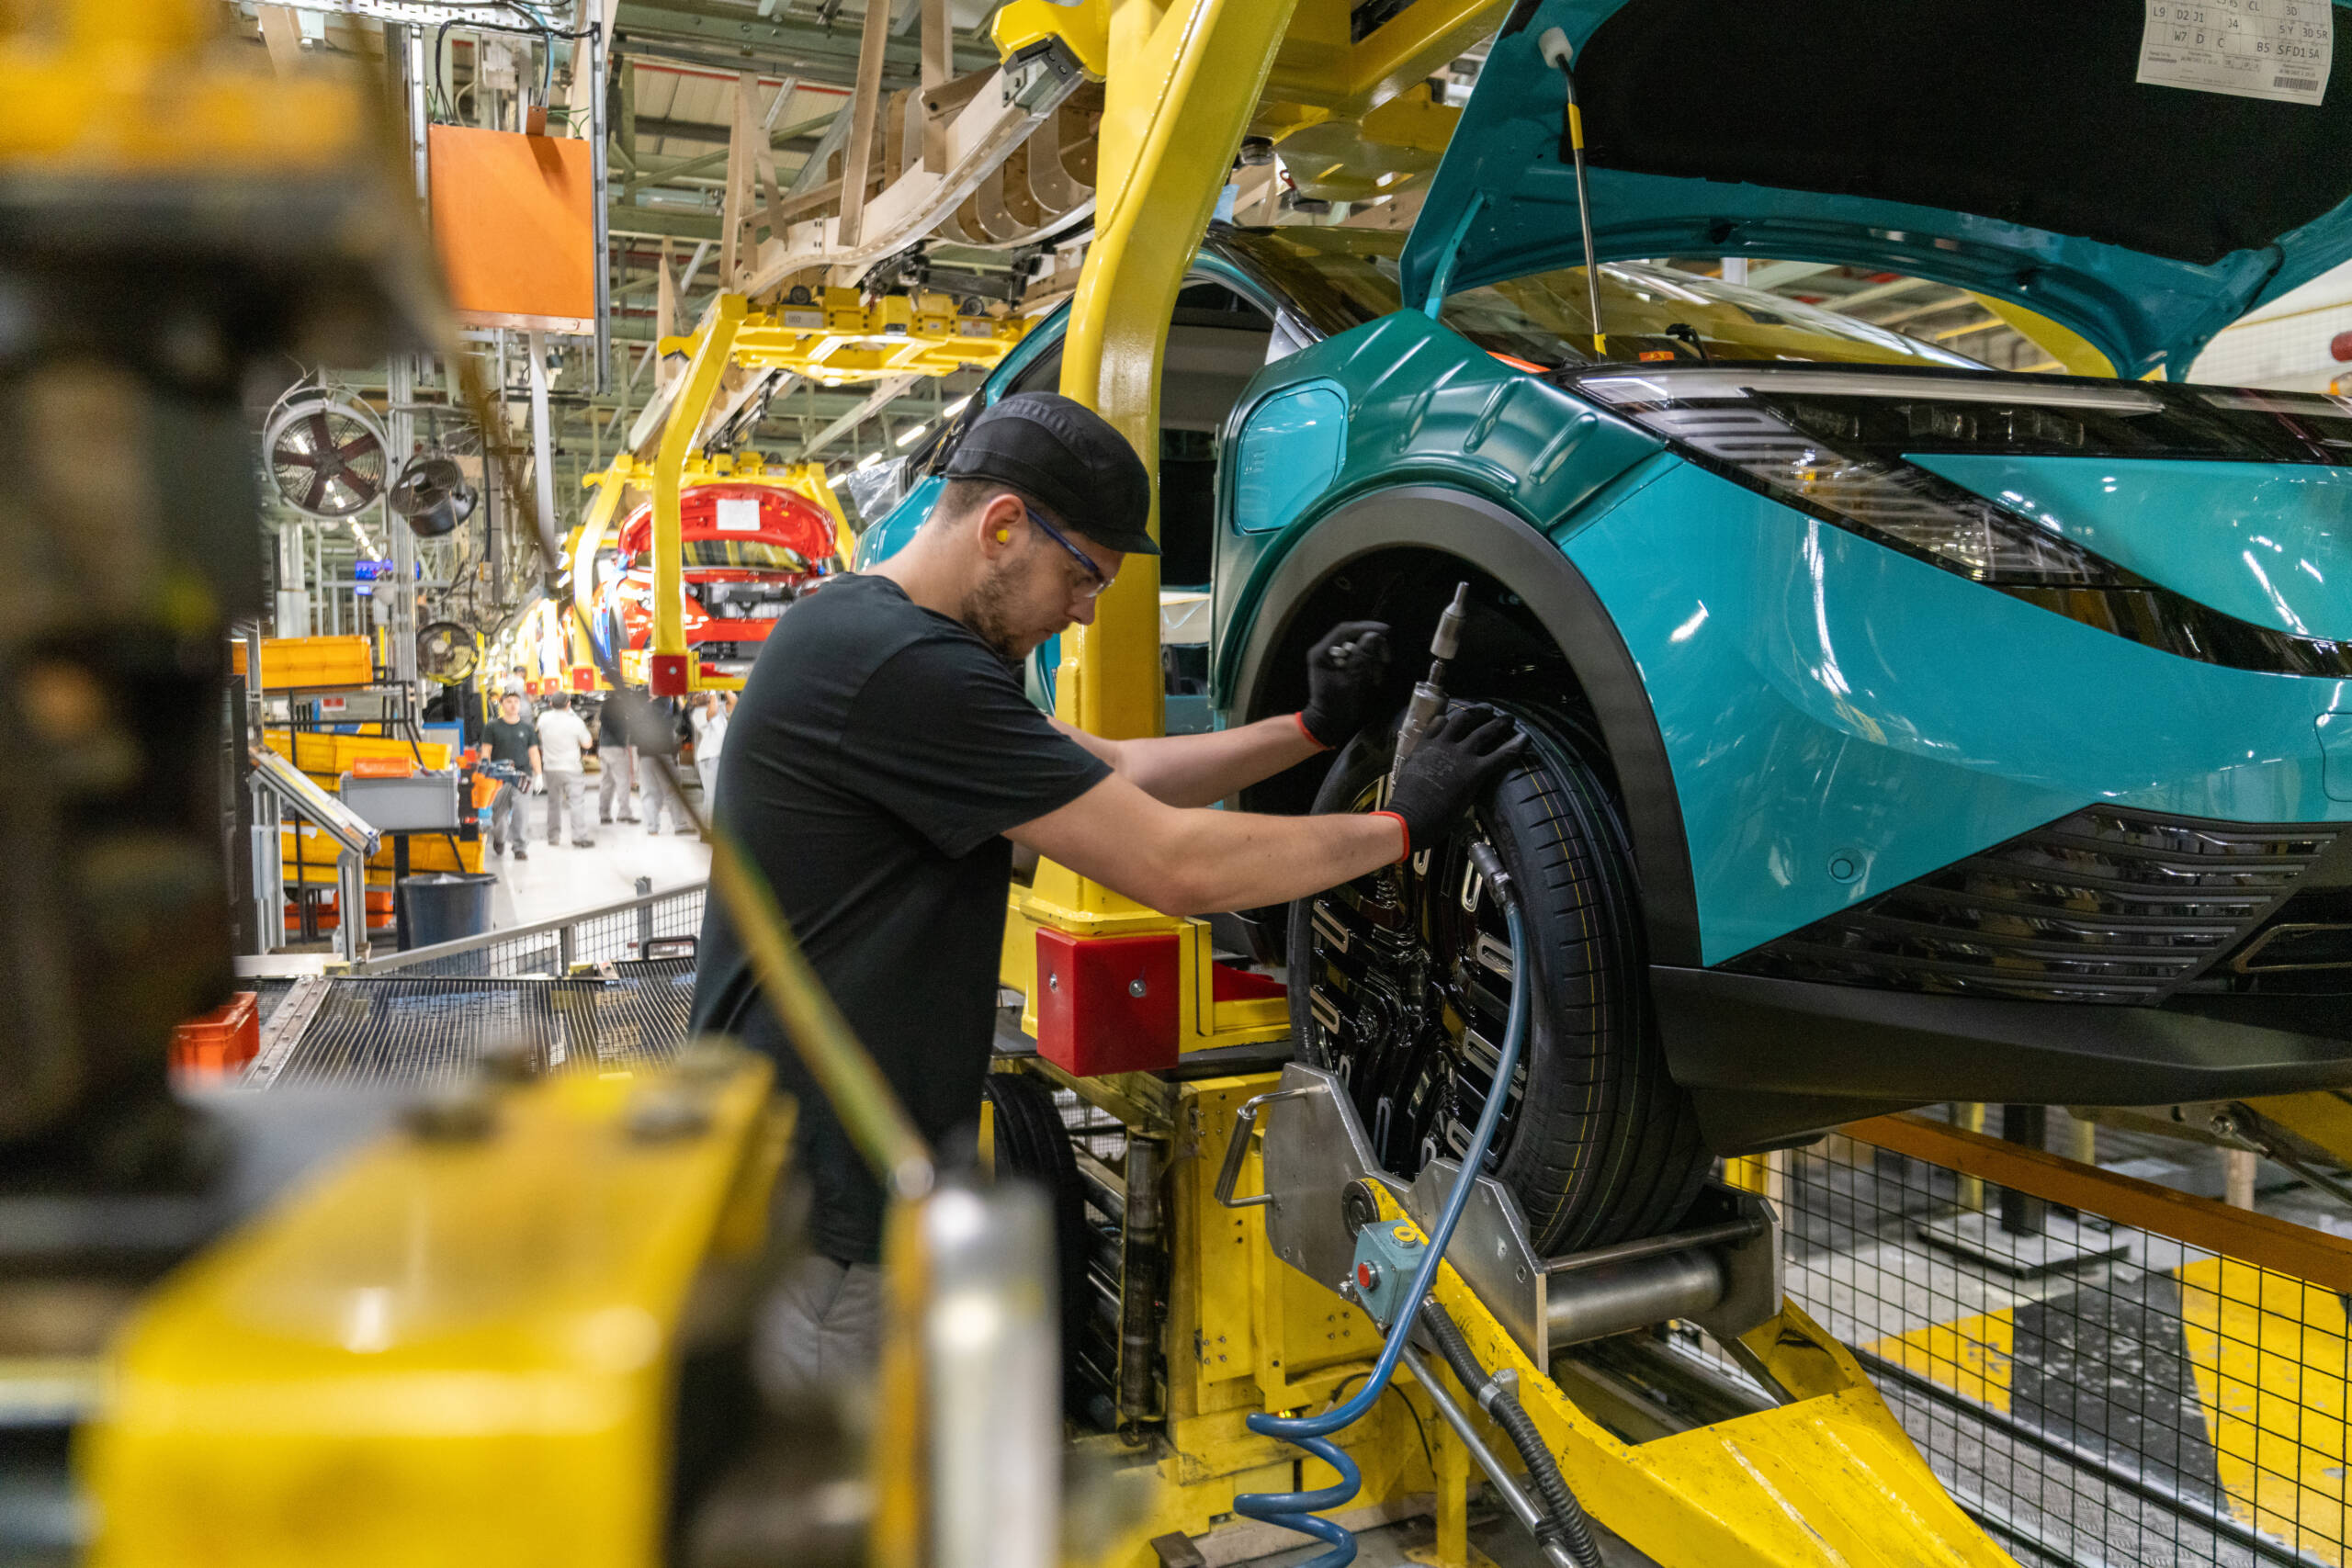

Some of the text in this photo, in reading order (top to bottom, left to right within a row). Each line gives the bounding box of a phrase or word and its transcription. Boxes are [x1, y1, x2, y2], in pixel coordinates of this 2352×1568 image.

[2154, 7, 2165, 17] L9
[2177, 9, 2189, 20] D2
[2174, 31, 2188, 42] W7
[2197, 33, 2204, 44] D
[2218, 38, 2225, 48] C
